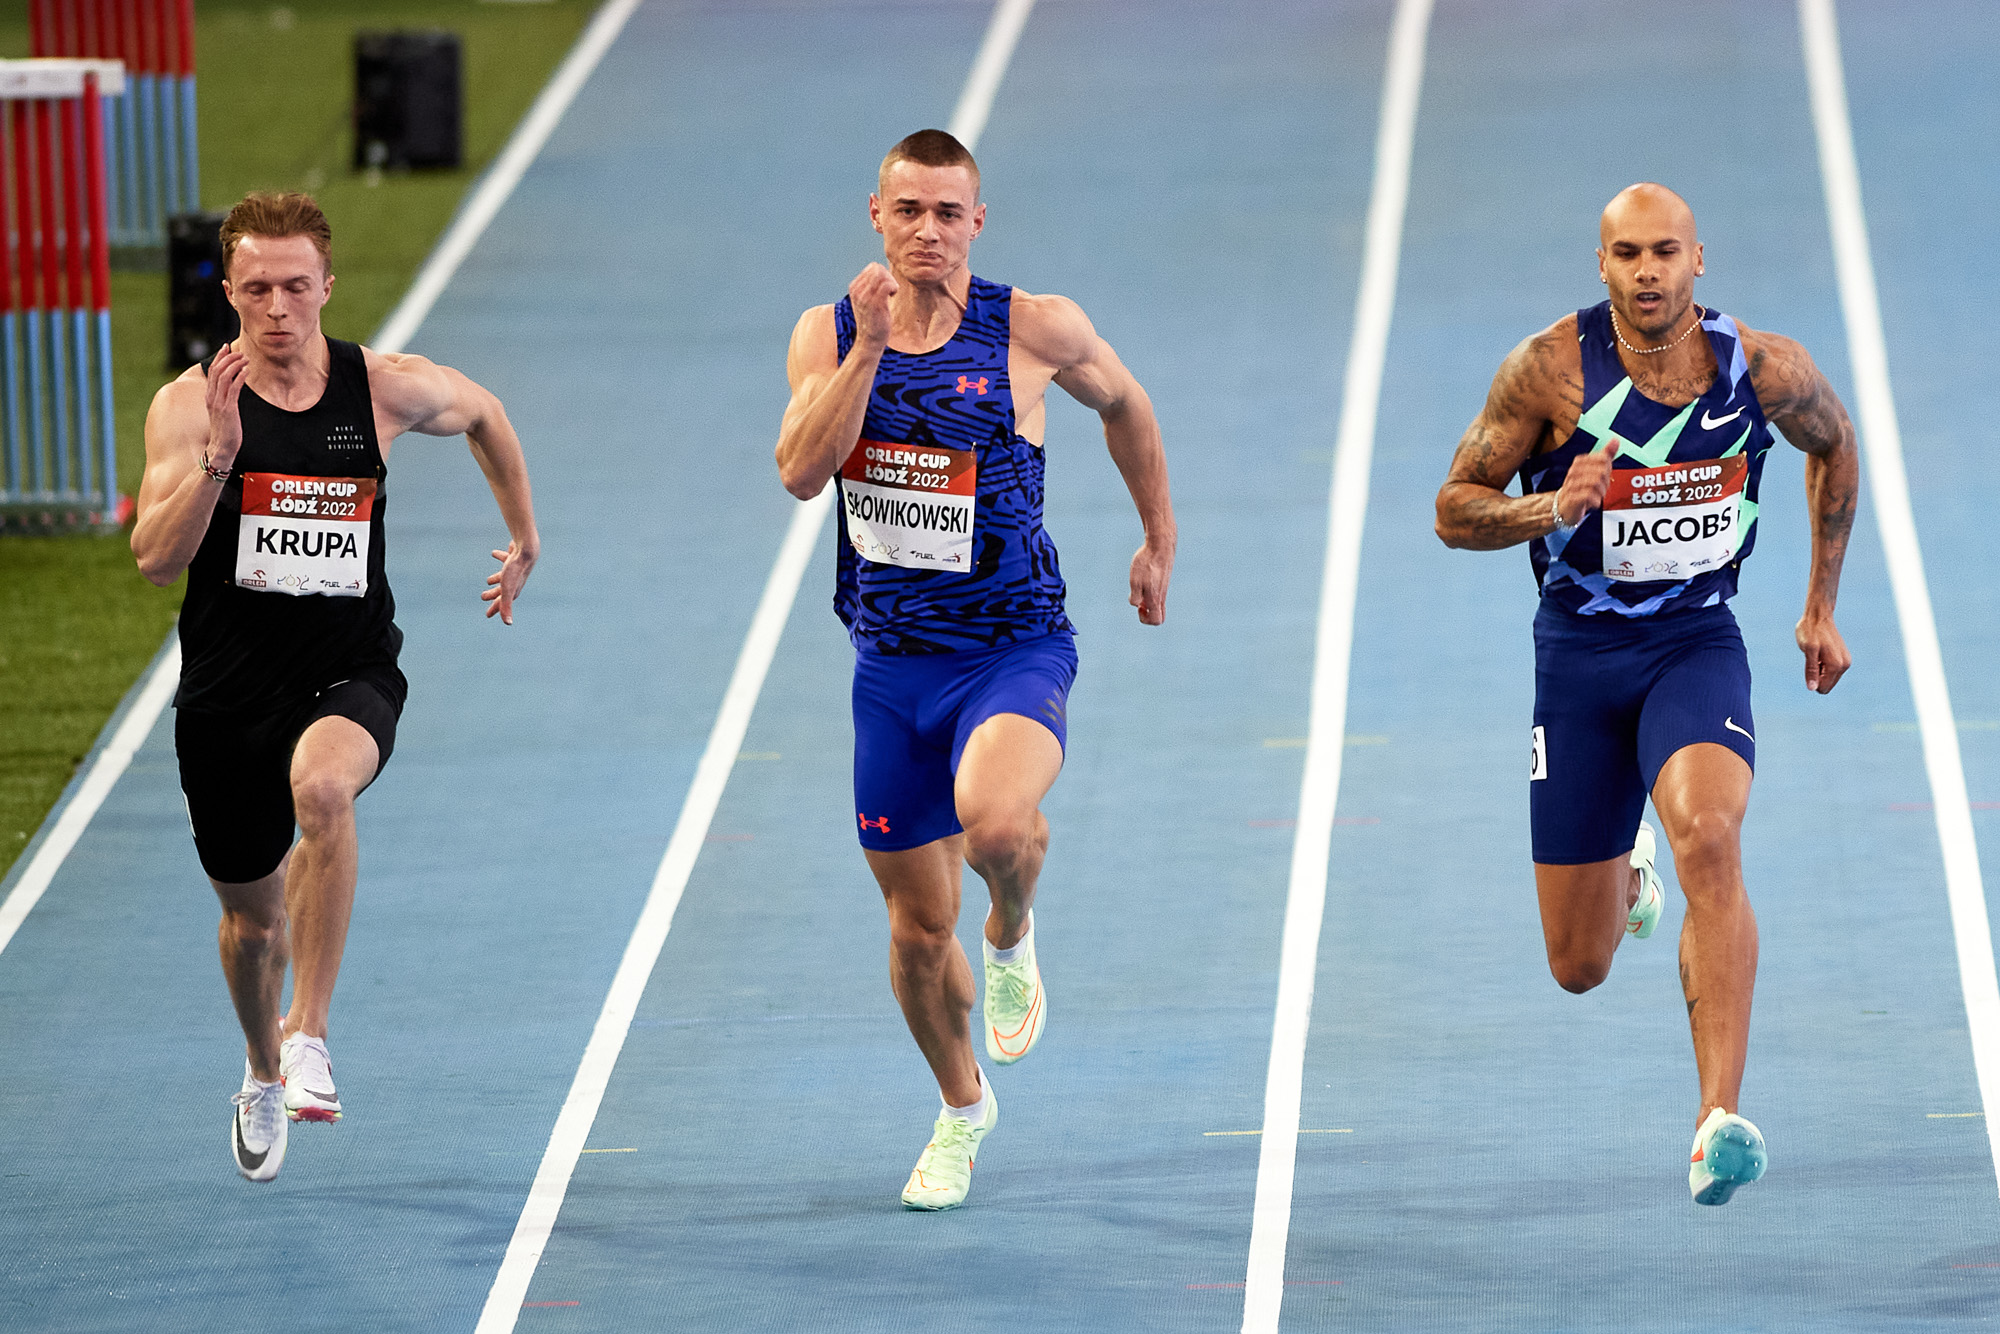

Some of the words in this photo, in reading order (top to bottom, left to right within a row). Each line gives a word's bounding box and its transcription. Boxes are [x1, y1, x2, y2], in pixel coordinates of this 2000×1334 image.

[865, 447, 917, 466] ORLEN
[918, 453, 951, 469] CUP
[865, 464, 909, 485] ŁÓDŹ
[911, 471, 949, 489] 2022
[1630, 469, 1688, 488] ORLEN
[1689, 465, 1723, 482] CUP
[271, 480, 325, 496] ORLEN
[327, 482, 358, 497] CUP
[1631, 485, 1682, 505] ŁÓDŹ
[1685, 483, 1723, 501] 2022
[270, 495, 318, 514] ŁÓDŹ
[321, 501, 356, 516] 2022
[847, 491, 969, 534] SŁOWIKOWSKI
[1611, 506, 1732, 547] JACOBS
[255, 527, 358, 559] KRUPA
[242, 579, 266, 588] ORLEN
[1609, 569, 1634, 577] ORLEN
